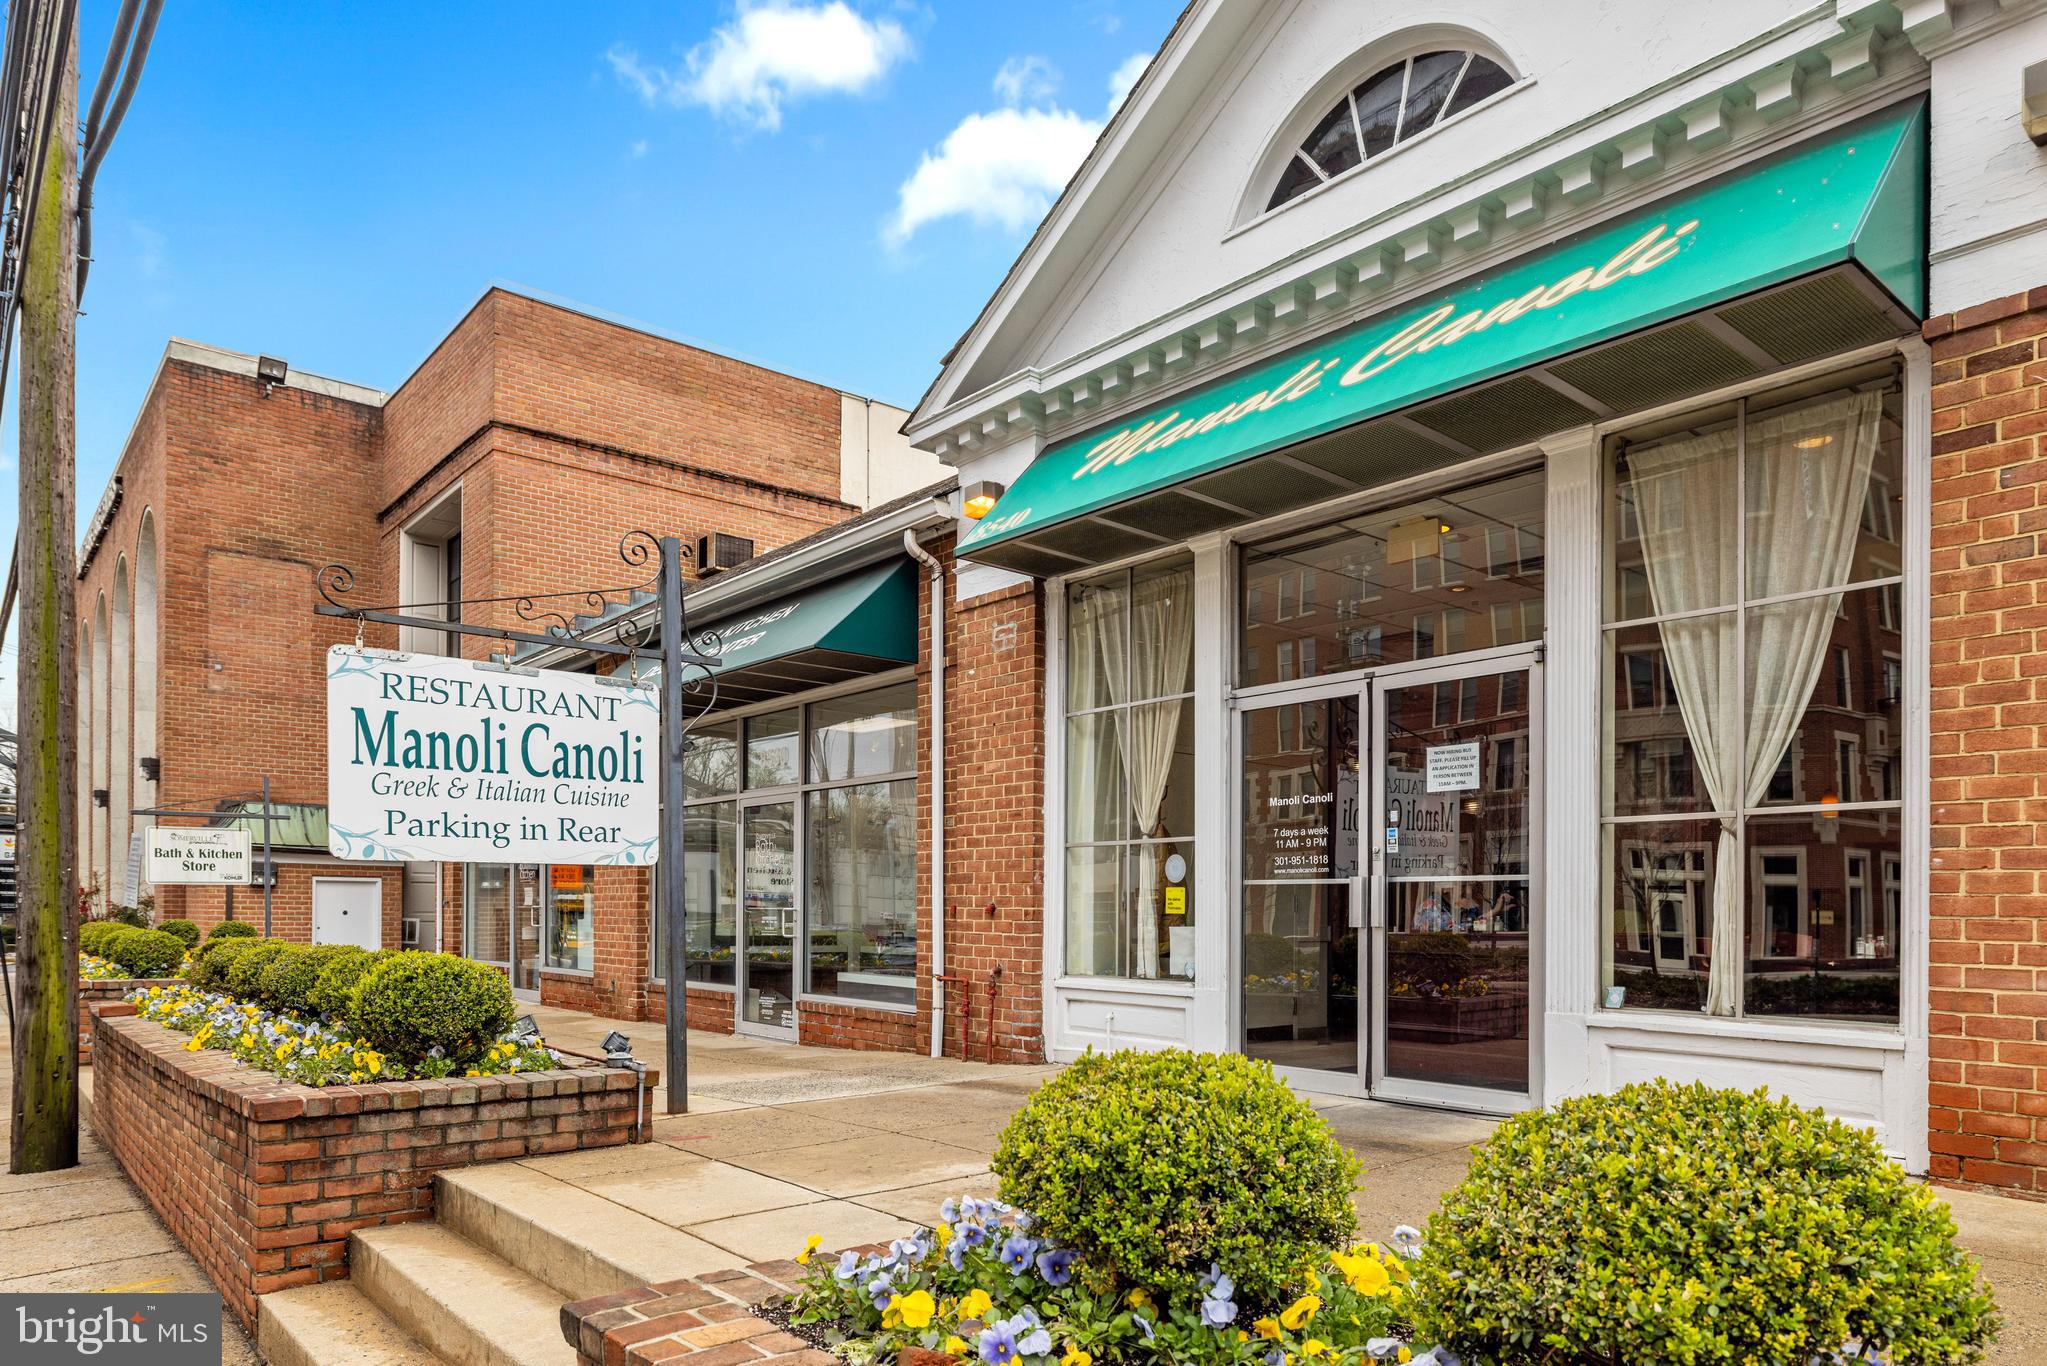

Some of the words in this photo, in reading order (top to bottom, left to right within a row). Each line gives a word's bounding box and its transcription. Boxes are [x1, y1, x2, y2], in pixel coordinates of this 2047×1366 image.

[1071, 357, 1340, 480] Manoli
[1340, 220, 1698, 386] Canoli
[720, 602, 801, 639] KITCHEN
[380, 671, 622, 722] RESTAURANT
[351, 706, 509, 774] Manoli
[521, 722, 644, 783] Canoli
[371, 772, 440, 797] Greek
[447, 777, 469, 799] &
[475, 778, 546, 803] Italian
[553, 783, 630, 807] Cuisine
[1269, 796, 1300, 807] Manoli
[1302, 792, 1333, 804] Canoli
[384, 809, 510, 848] Parking
[519, 816, 548, 841] in
[557, 817, 621, 843] Rear
[1274, 829, 1279, 837] 7
[1280, 828, 1298, 838] days
[1308, 826, 1329, 835] week
[154, 847, 182, 858] Bath
[186, 848, 195, 858] &
[199, 848, 243, 859] Kitchen
[1276, 840, 1283, 848] 11
[1286, 839, 1299, 848] AM
[1306, 838, 1311, 847] 9
[1314, 838, 1327, 847] PM
[182, 860, 216, 871] Store
[1274, 855, 1329, 866] 301-951-1818
